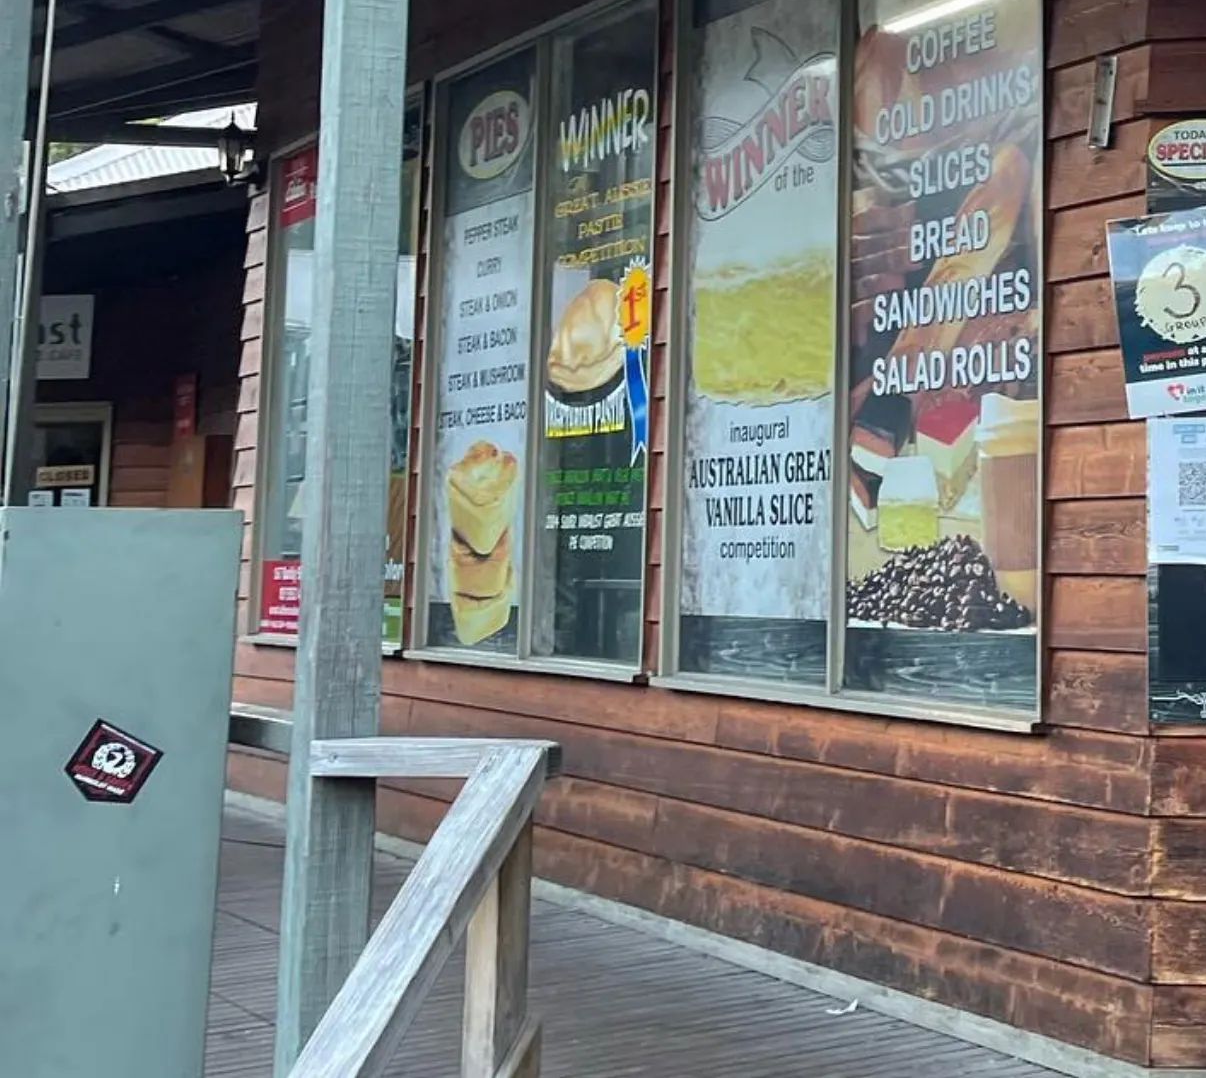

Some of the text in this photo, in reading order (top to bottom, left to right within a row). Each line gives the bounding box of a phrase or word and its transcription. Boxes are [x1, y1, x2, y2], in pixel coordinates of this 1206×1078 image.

[906, 10, 997, 73] COFFEE
[561, 88, 650, 172] WINNER
[875, 65, 1033, 145] COLD DRINKS
[469, 101, 520, 167] PIES
[703, 77, 831, 212] WINNER
[774, 165, 815, 193] of the
[909, 141, 991, 198] SLICES
[910, 210, 991, 263] BREAD
[459, 295, 485, 318] STEAK
[873, 269, 1032, 333] SANDWICHES
[1162, 262, 1201, 318] 3
[457, 335, 483, 355] STEAK
[489, 326, 518, 349] BACON
[1139, 363, 1165, 373] time
[1166, 360, 1177, 370] in
[1179, 358, 1199, 368] this
[448, 374, 472, 393] STEAK
[872, 338, 1032, 397] SALAD ROLLS
[729, 416, 790, 447] inaugural
[689, 453, 781, 489] AUSTRALIAN
[705, 492, 814, 527] VANILLA SLICE
[719, 535, 796, 565] competition
